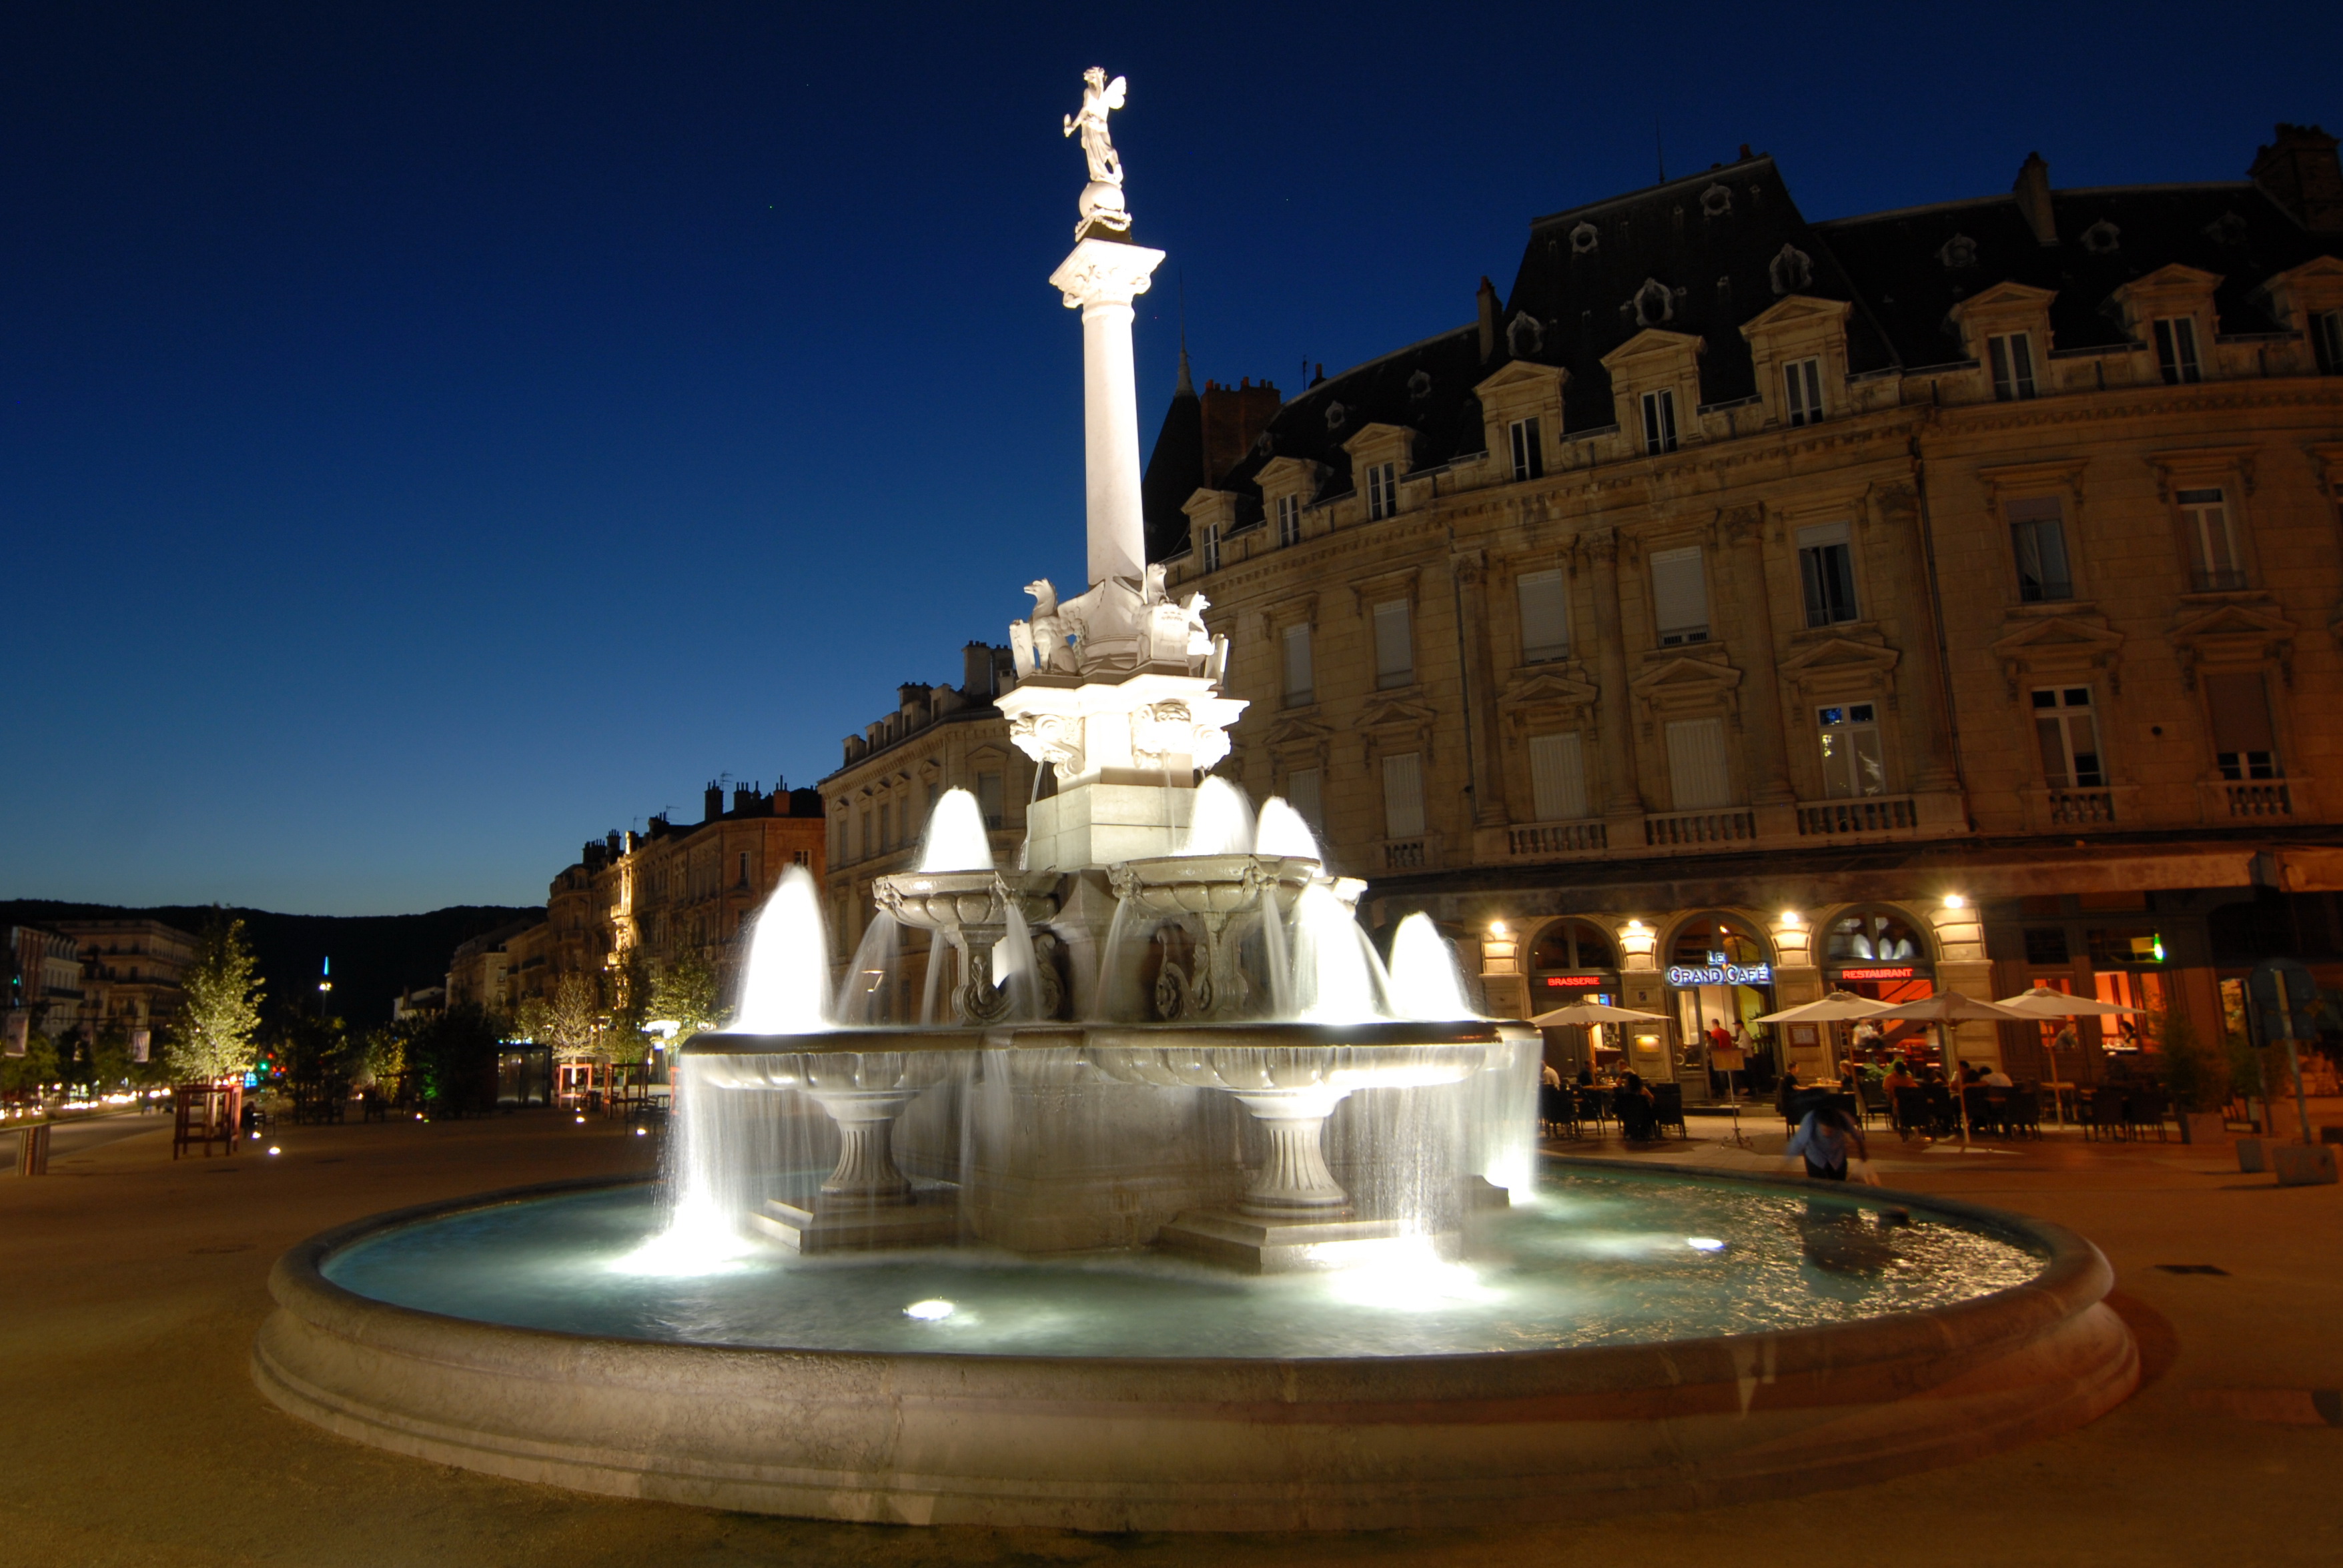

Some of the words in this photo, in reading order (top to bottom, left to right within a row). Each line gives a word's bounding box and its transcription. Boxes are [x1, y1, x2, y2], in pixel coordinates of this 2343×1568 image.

[1707, 950, 1727, 965] LE
[1669, 966, 1724, 986] GRAND
[1725, 962, 1770, 984] CAFÉ
[1843, 968, 1913, 979] RESTAURANT
[1548, 976, 1600, 986] BRASSERIE
